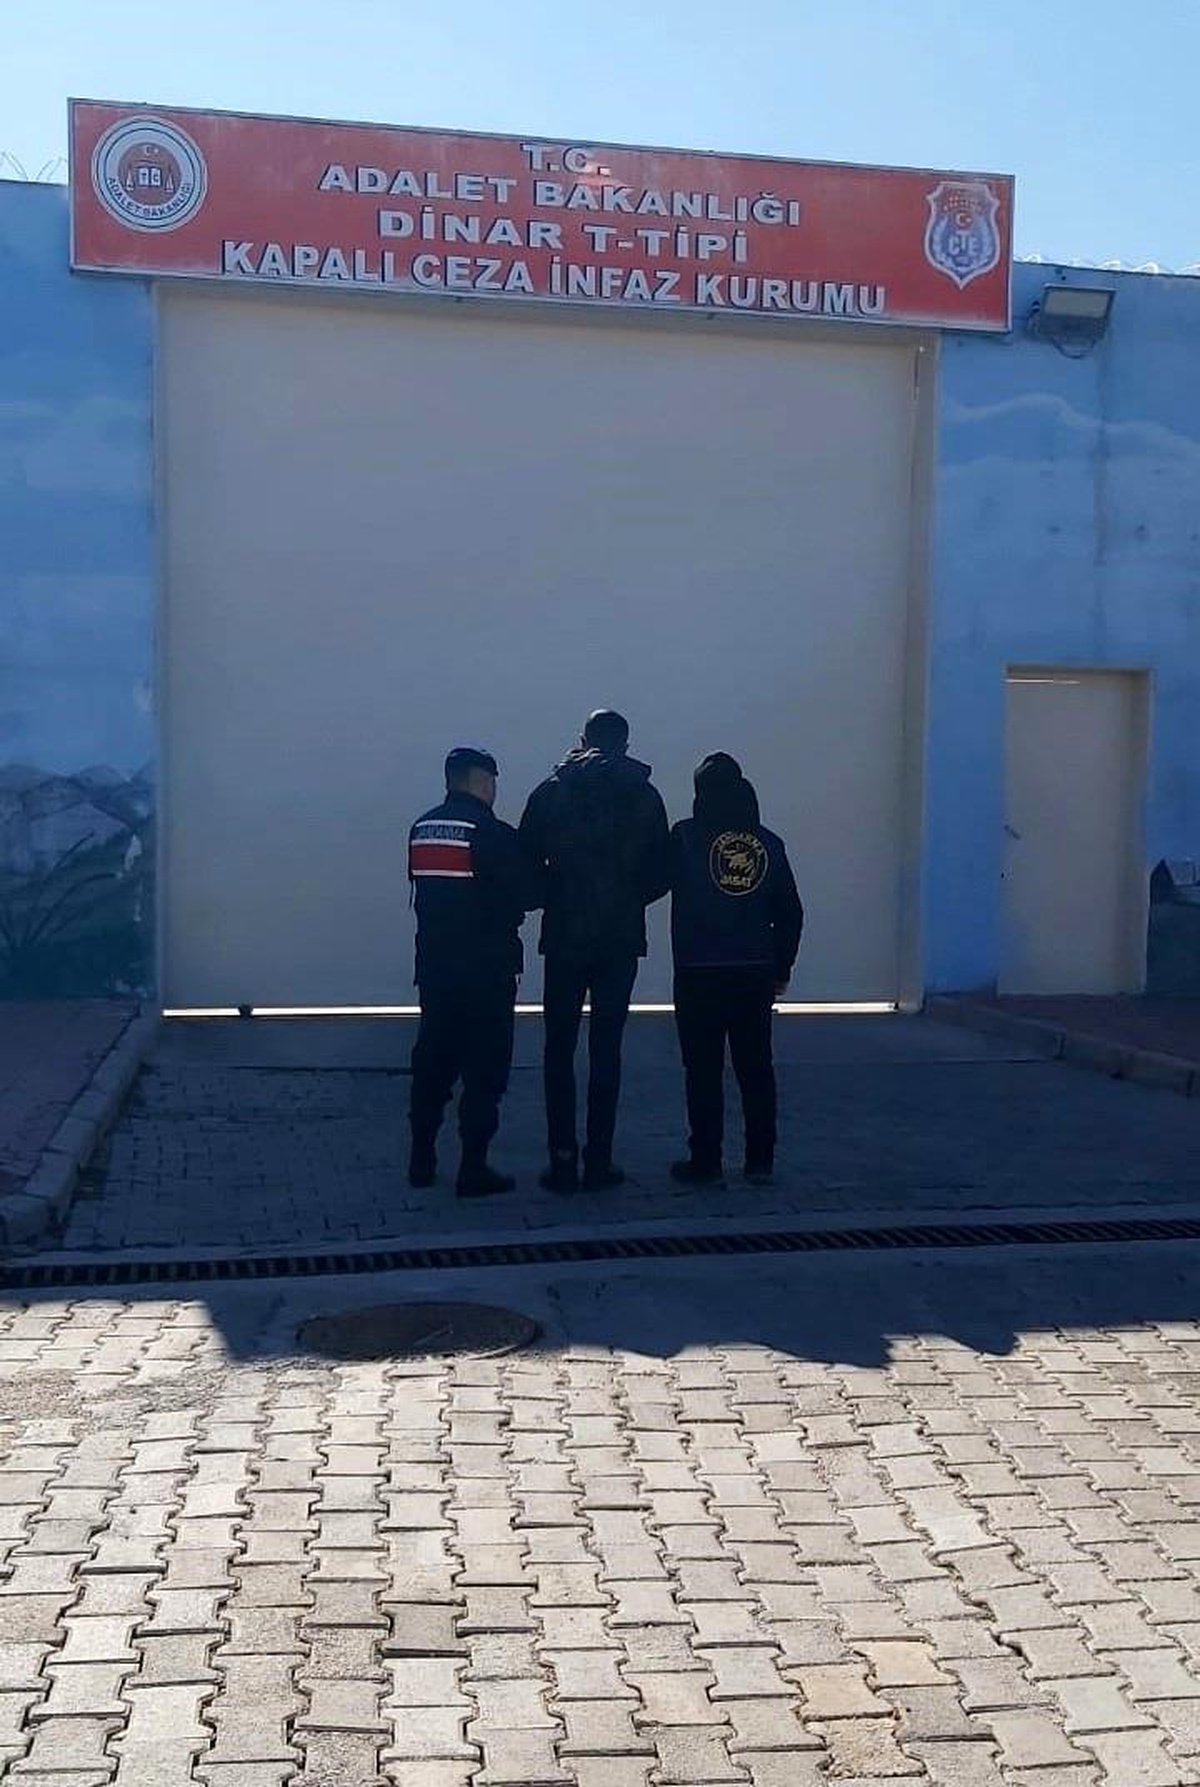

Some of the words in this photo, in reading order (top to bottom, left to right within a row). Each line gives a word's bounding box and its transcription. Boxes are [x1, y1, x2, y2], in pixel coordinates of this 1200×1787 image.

[521, 143, 611, 176] T.C.
[319, 164, 517, 203] ADALET
[535, 180, 800, 226] BAKANLIĞI
[378, 205, 563, 249] DİNAR
[582, 223, 747, 263] T-TİPİ
[223, 240, 394, 283] KAPALI
[412, 253, 534, 293] CEZA
[550, 256, 681, 301] İNFAZ
[696, 273, 885, 316] KURUMU
